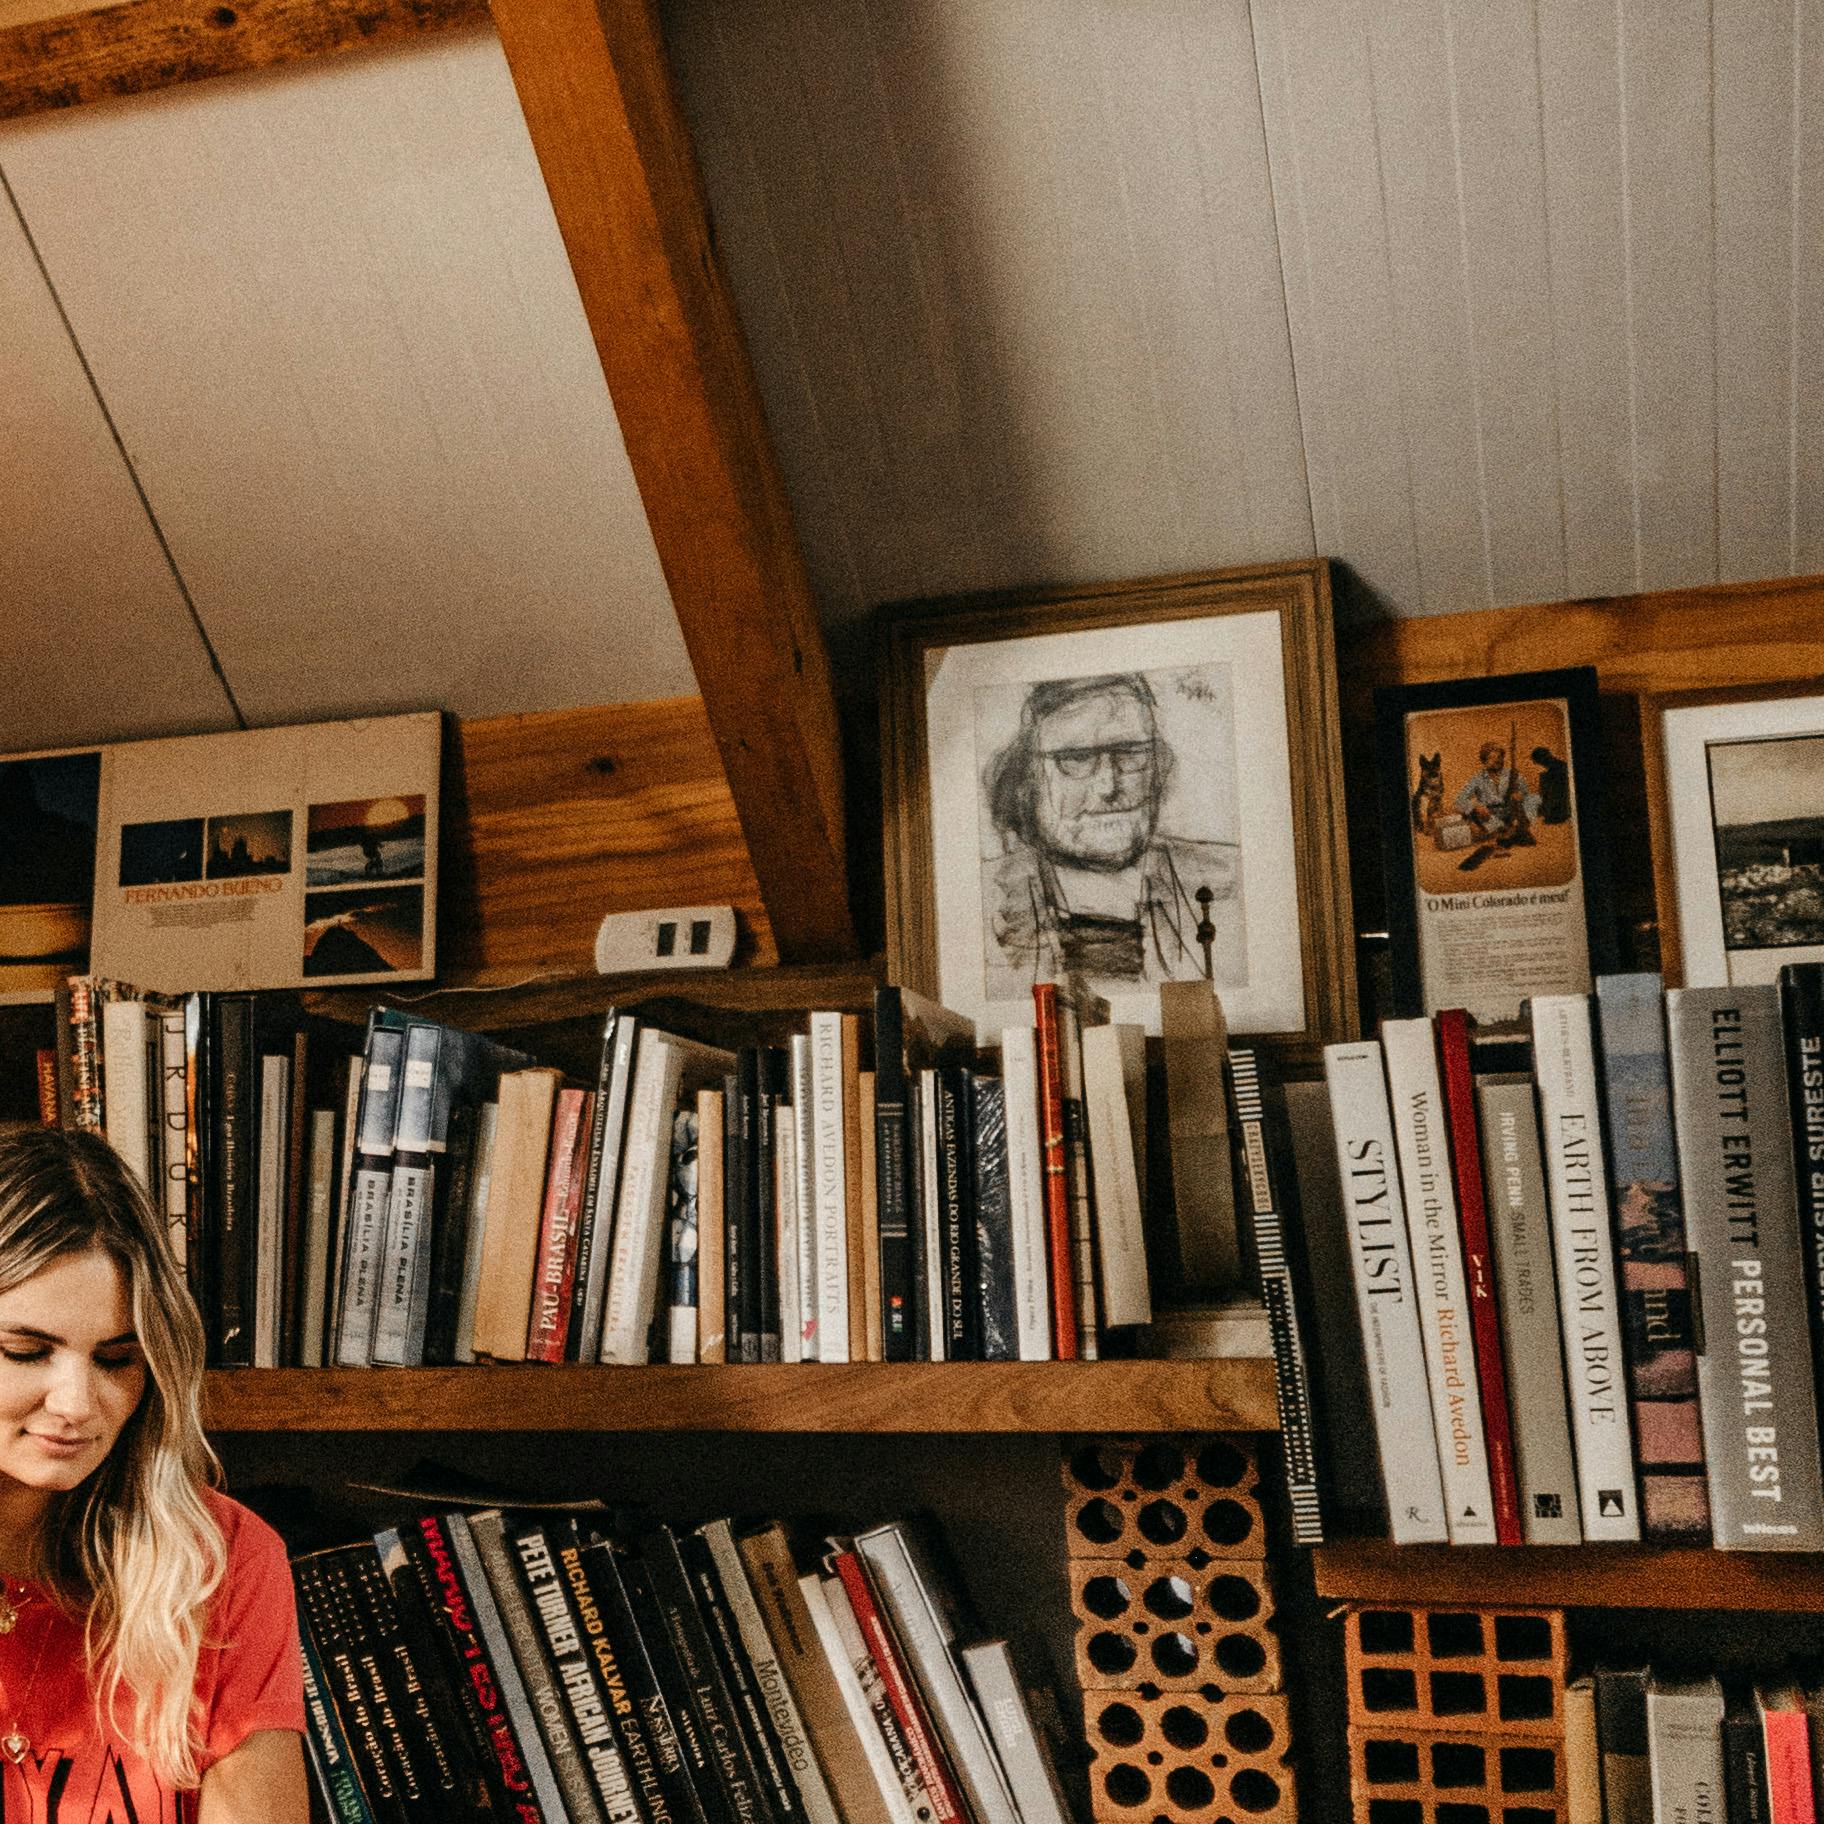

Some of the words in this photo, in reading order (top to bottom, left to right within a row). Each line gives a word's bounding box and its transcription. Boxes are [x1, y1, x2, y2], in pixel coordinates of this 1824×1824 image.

[125, 883, 219, 904] FERNANDO
[222, 877, 283, 896] BUENO
[1472, 893, 1528, 908] Colorado
[41, 1062, 57, 1122] HAVANA
[817, 1022, 835, 1111] RICHARD
[1710, 1008, 1749, 1124] ELLIOTT
[943, 1090, 955, 1140] ANTIGAS
[1410, 1090, 1436, 1168] Woman
[1498, 1111, 1518, 1162] IRVING
[821, 1119, 838, 1197] AVEDON
[945, 1143, 958, 1200] FAZENDAS
[1420, 1172, 1440, 1194] in
[1504, 1166, 1523, 1206] PENN
[1557, 1111, 1595, 1215] EARTH
[360, 1179, 377, 1253] BRASÍLIA
[400, 1176, 418, 1251] BRASÍLIA
[948, 1202, 959, 1222] DO
[1423, 1196, 1444, 1230] the
[1720, 1133, 1760, 1249] ERWITT
[949, 1223, 960, 1244] RIO
[1344, 1136, 1405, 1308] STYLIST
[1509, 1210, 1528, 1258] SMALL
[355, 1258, 368, 1307] PLENA
[394, 1256, 407, 1305] PLENA
[538, 1208, 571, 1330] PAU-BRASIL
[823, 1205, 843, 1314] PORTRAITS
[949, 1246, 962, 1295] GRANDE
[1427, 1233, 1452, 1301] Mirror
[1514, 1260, 1535, 1315] TRADES
[1568, 1225, 1605, 1314] FROM
[951, 1298, 962, 1318] DO
[952, 1319, 963, 1339] SUL
[1730, 1258, 1774, 1416] PERSONAL
[1436, 1306, 1465, 1389] Richard
[1578, 1323, 1617, 1426] ABOVE
[1446, 1391, 1474, 1467] Avedon
[1744, 1424, 1782, 1504] BEST
[515, 1532, 555, 1582] PETE
[530, 1579, 581, 1657] TURNER
[559, 1546, 604, 1636] RICHARD
[590, 1635, 633, 1716] KALVAR
[332, 1652, 362, 1702] Brasil
[359, 1654, 388, 1704] Brasil
[392, 1644, 422, 1694] Brasil
[486, 1547, 521, 1604] ANNIE
[533, 1683, 573, 1755] WOMEN
[351, 1704, 371, 1728] do
[377, 1705, 397, 1730] do
[411, 1695, 430, 1720] do
[557, 1657, 613, 1745] AFRICAN
[695, 1683, 723, 1724] Luiz
[753, 1657, 814, 1774] Montevideo
[359, 1728, 398, 1798] Coração
[385, 1730, 424, 1801] Coração
[419, 1720, 458, 1790] Coração
[708, 1721, 743, 1780] Carlos
